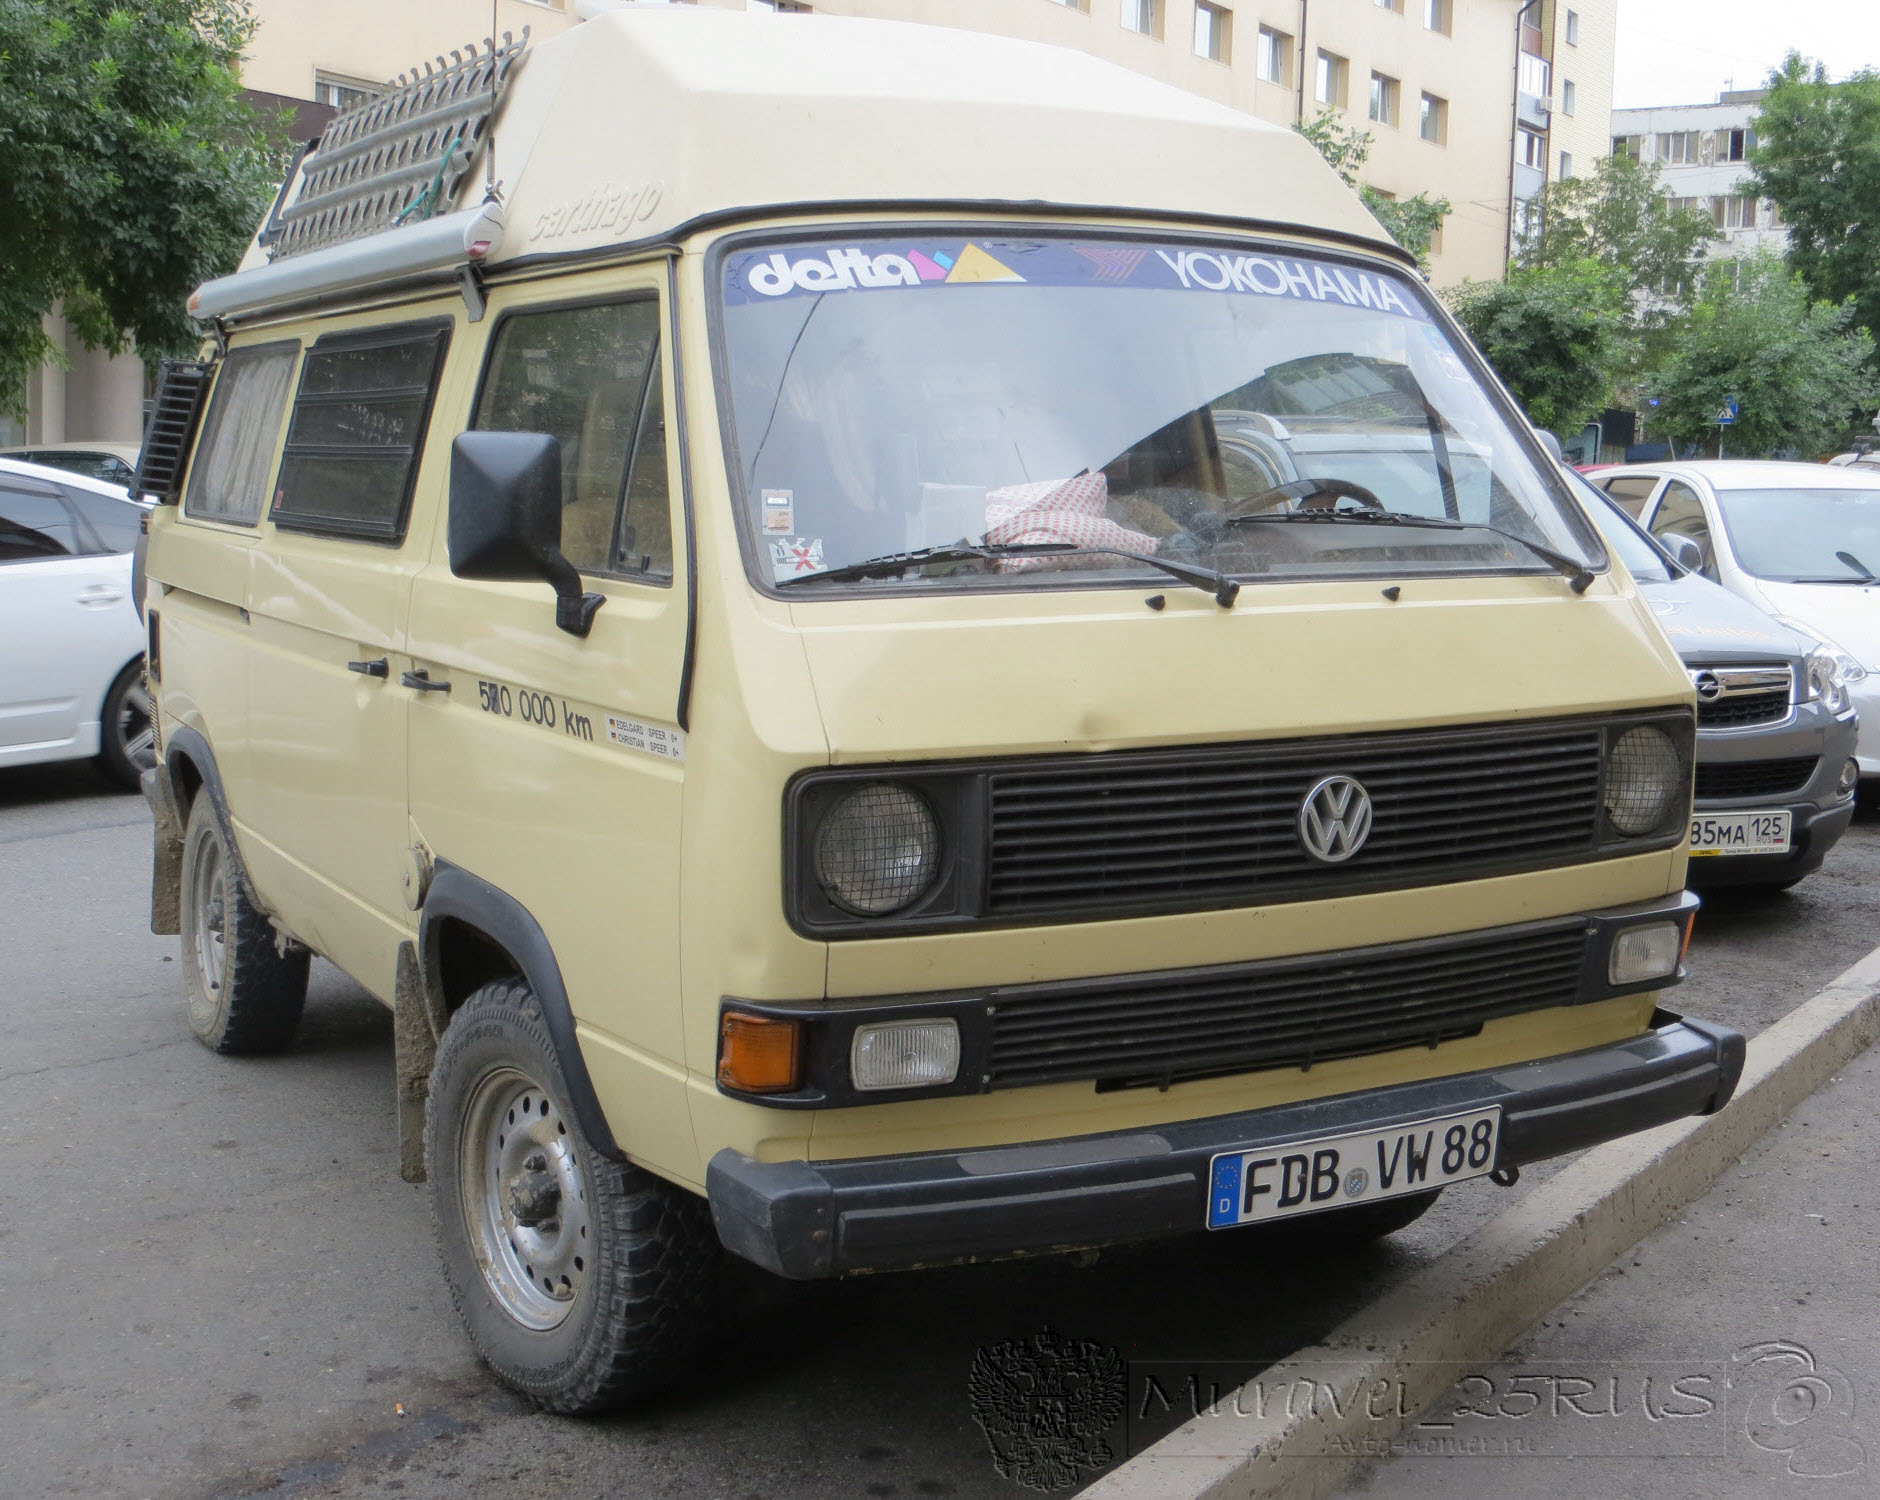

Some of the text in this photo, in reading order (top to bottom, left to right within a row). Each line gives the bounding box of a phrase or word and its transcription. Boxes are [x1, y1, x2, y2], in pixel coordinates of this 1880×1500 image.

[748, 248, 922, 297] delta
[1154, 249, 1412, 317] YOKOHAMA
[519, 689, 556, 729] 000
[562, 700, 594, 742] km
[616, 719, 644, 736] EDELGARD
[648, 728, 667, 742] SPEER
[617, 734, 645, 749] CHRISTIAN
[649, 741, 669, 756] SPEER
[1751, 816, 1783, 837] 125
[1756, 836, 1772, 844] RUS
[1219, 1198, 1231, 1214] D
[1243, 1148, 1340, 1214] FDB
